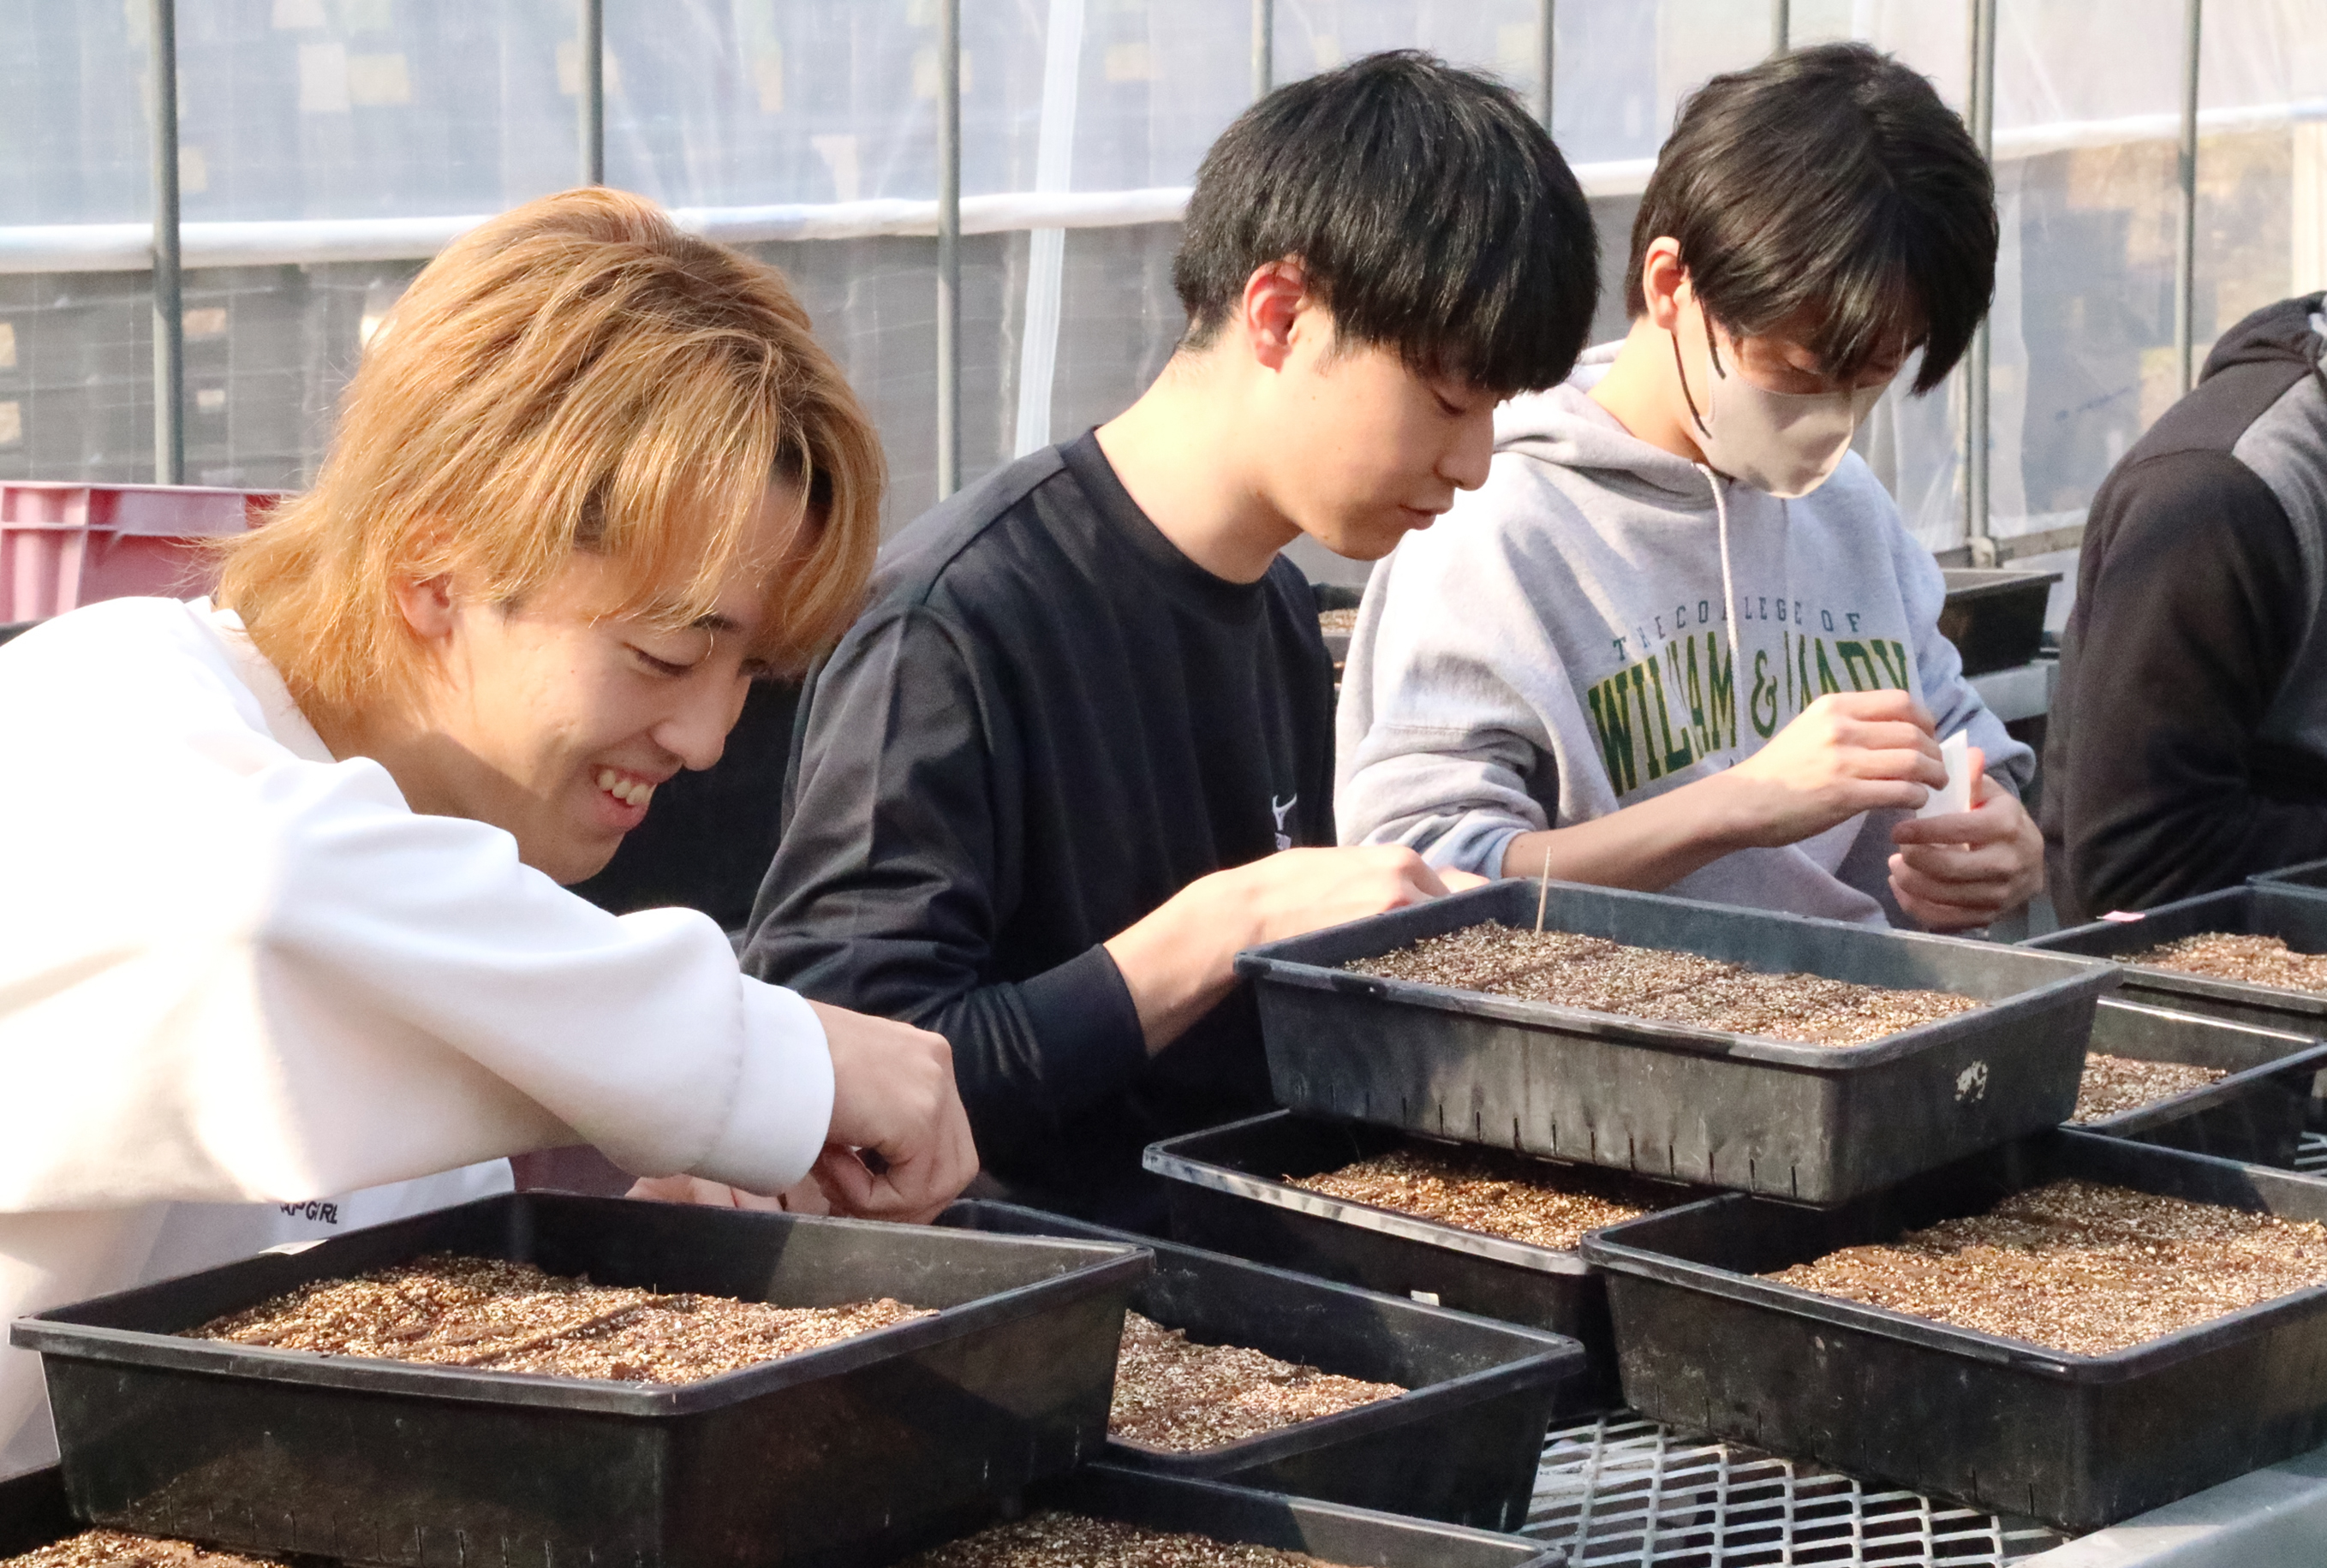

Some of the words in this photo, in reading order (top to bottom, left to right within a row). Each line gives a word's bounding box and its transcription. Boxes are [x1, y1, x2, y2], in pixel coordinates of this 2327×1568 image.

[1821, 610, 1860, 632] OF
[1587, 630, 1737, 797] WILAM
[1750, 649, 1778, 739] &
